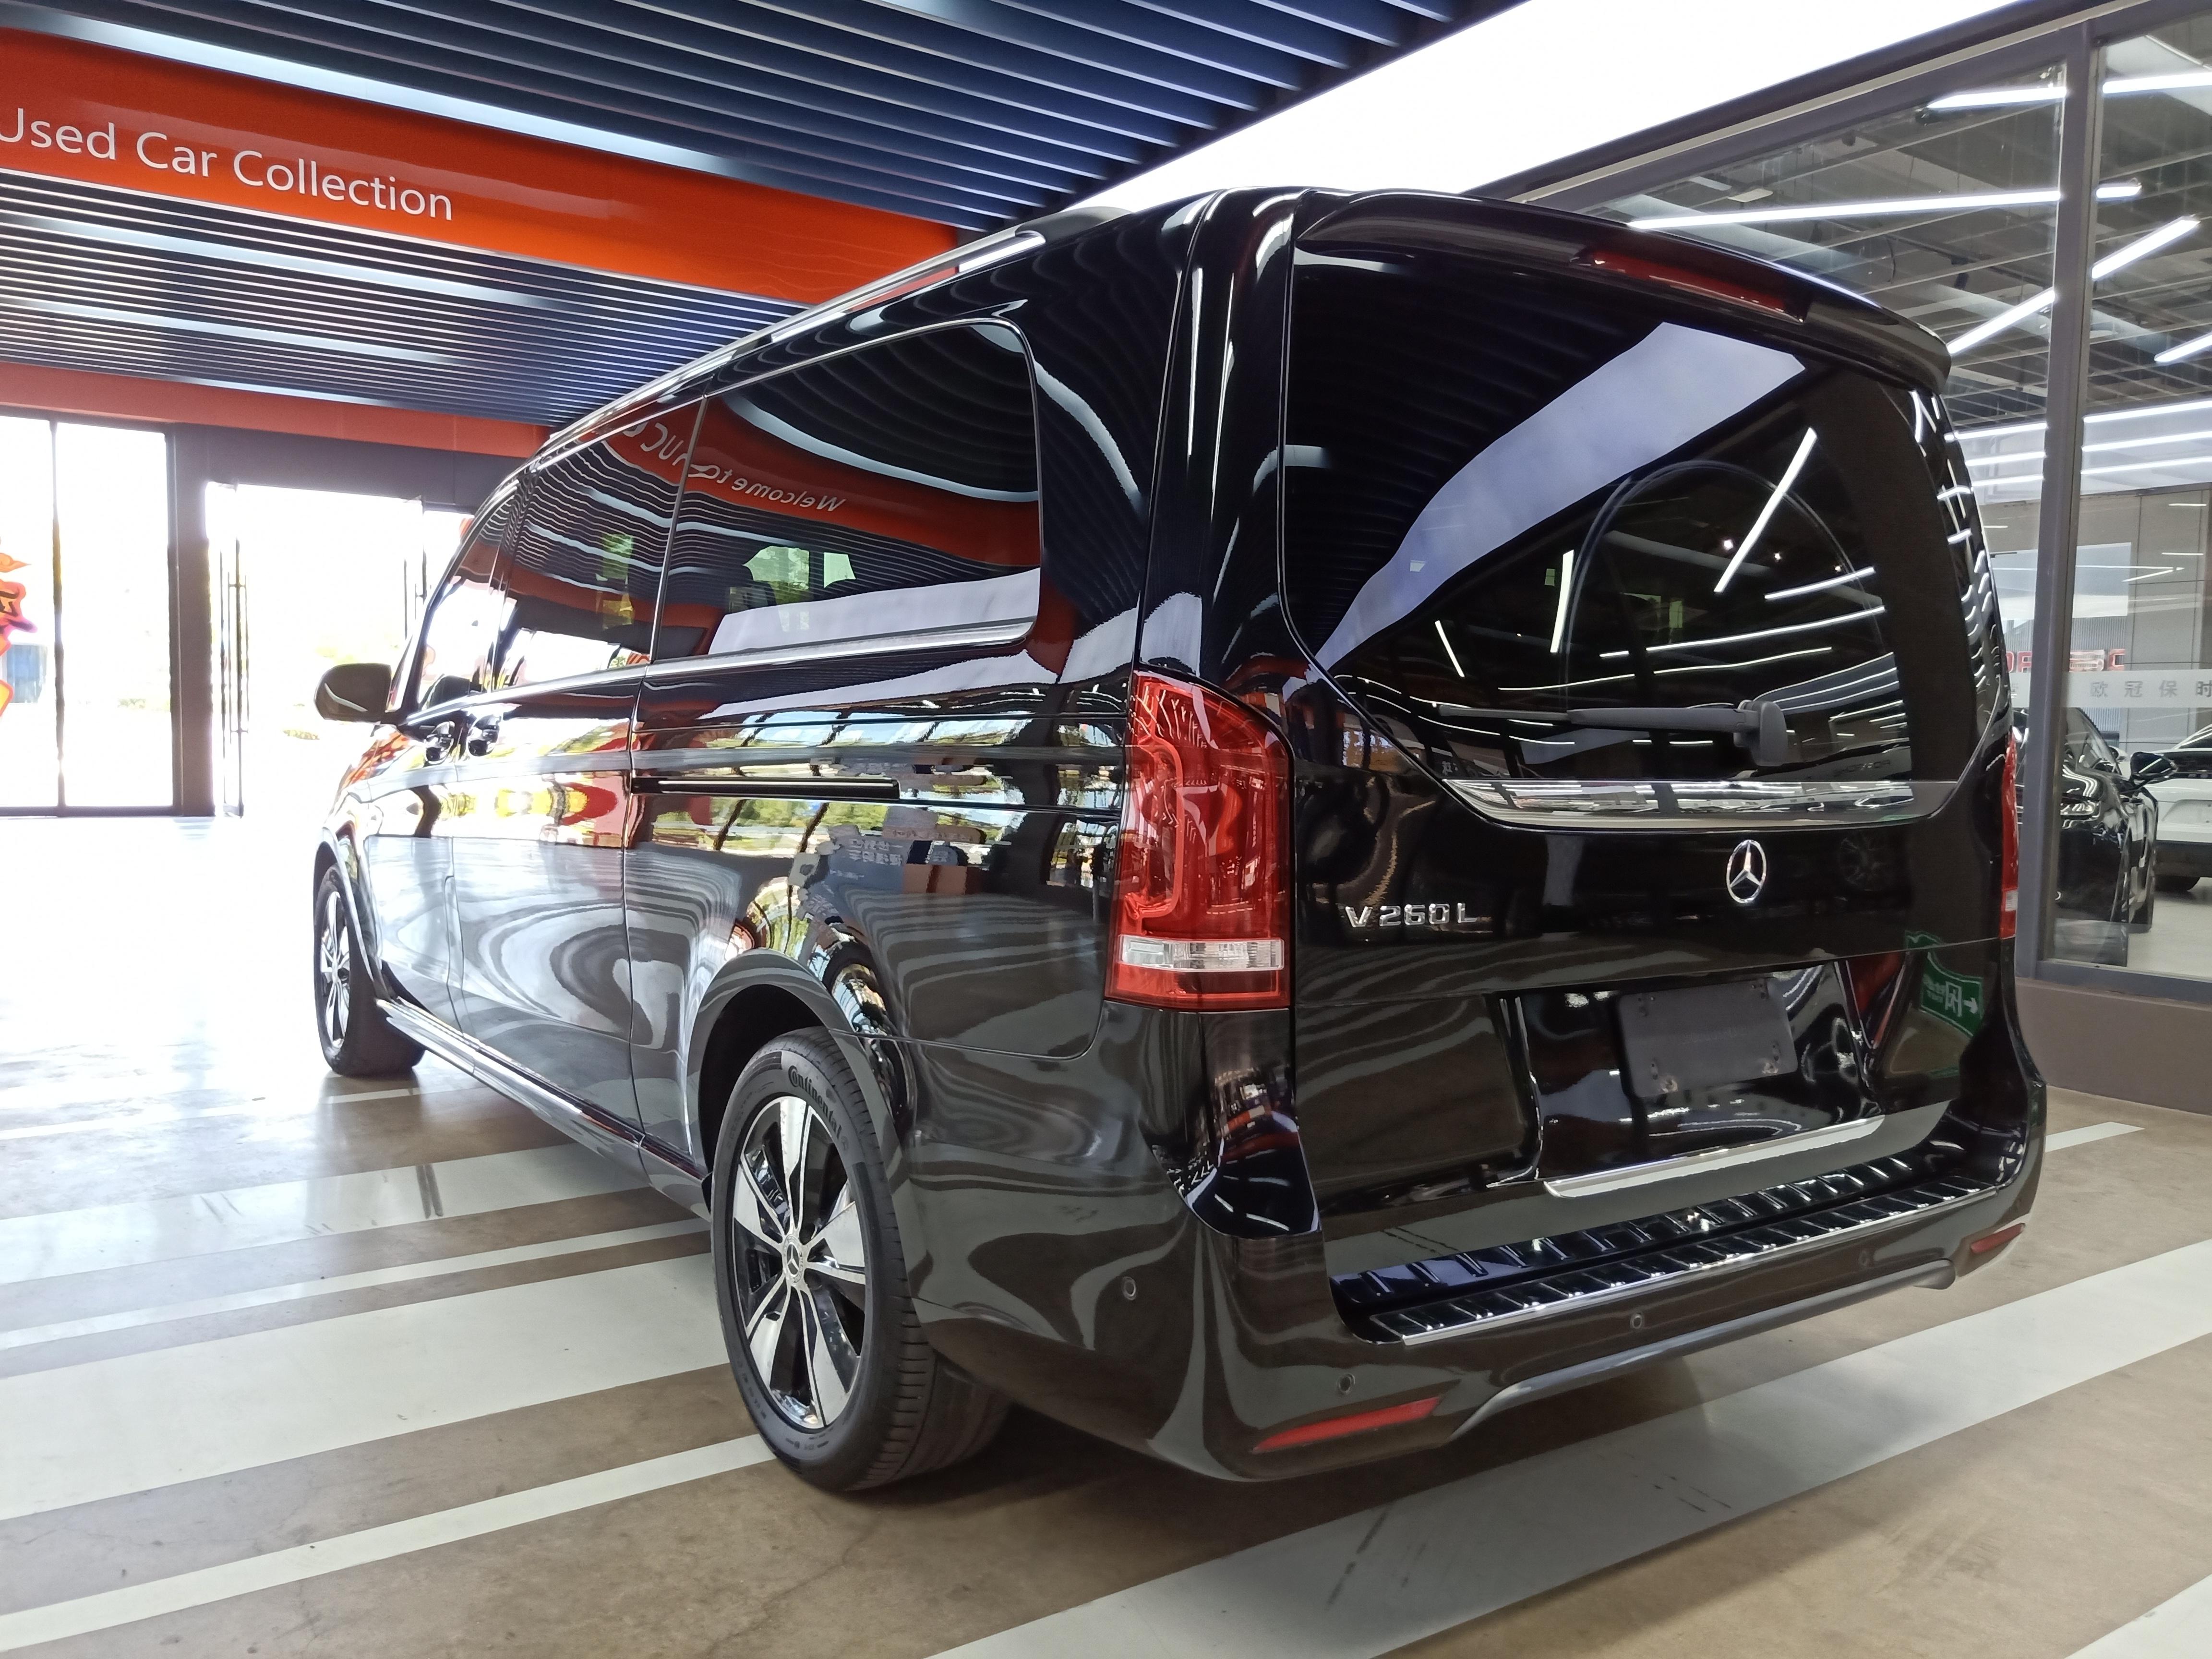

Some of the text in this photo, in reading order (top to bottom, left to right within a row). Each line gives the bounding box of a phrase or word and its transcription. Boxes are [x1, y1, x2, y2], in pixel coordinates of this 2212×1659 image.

[0, 108, 453, 221] Used Car Collection
[788, 1065, 842, 1139] Continental
